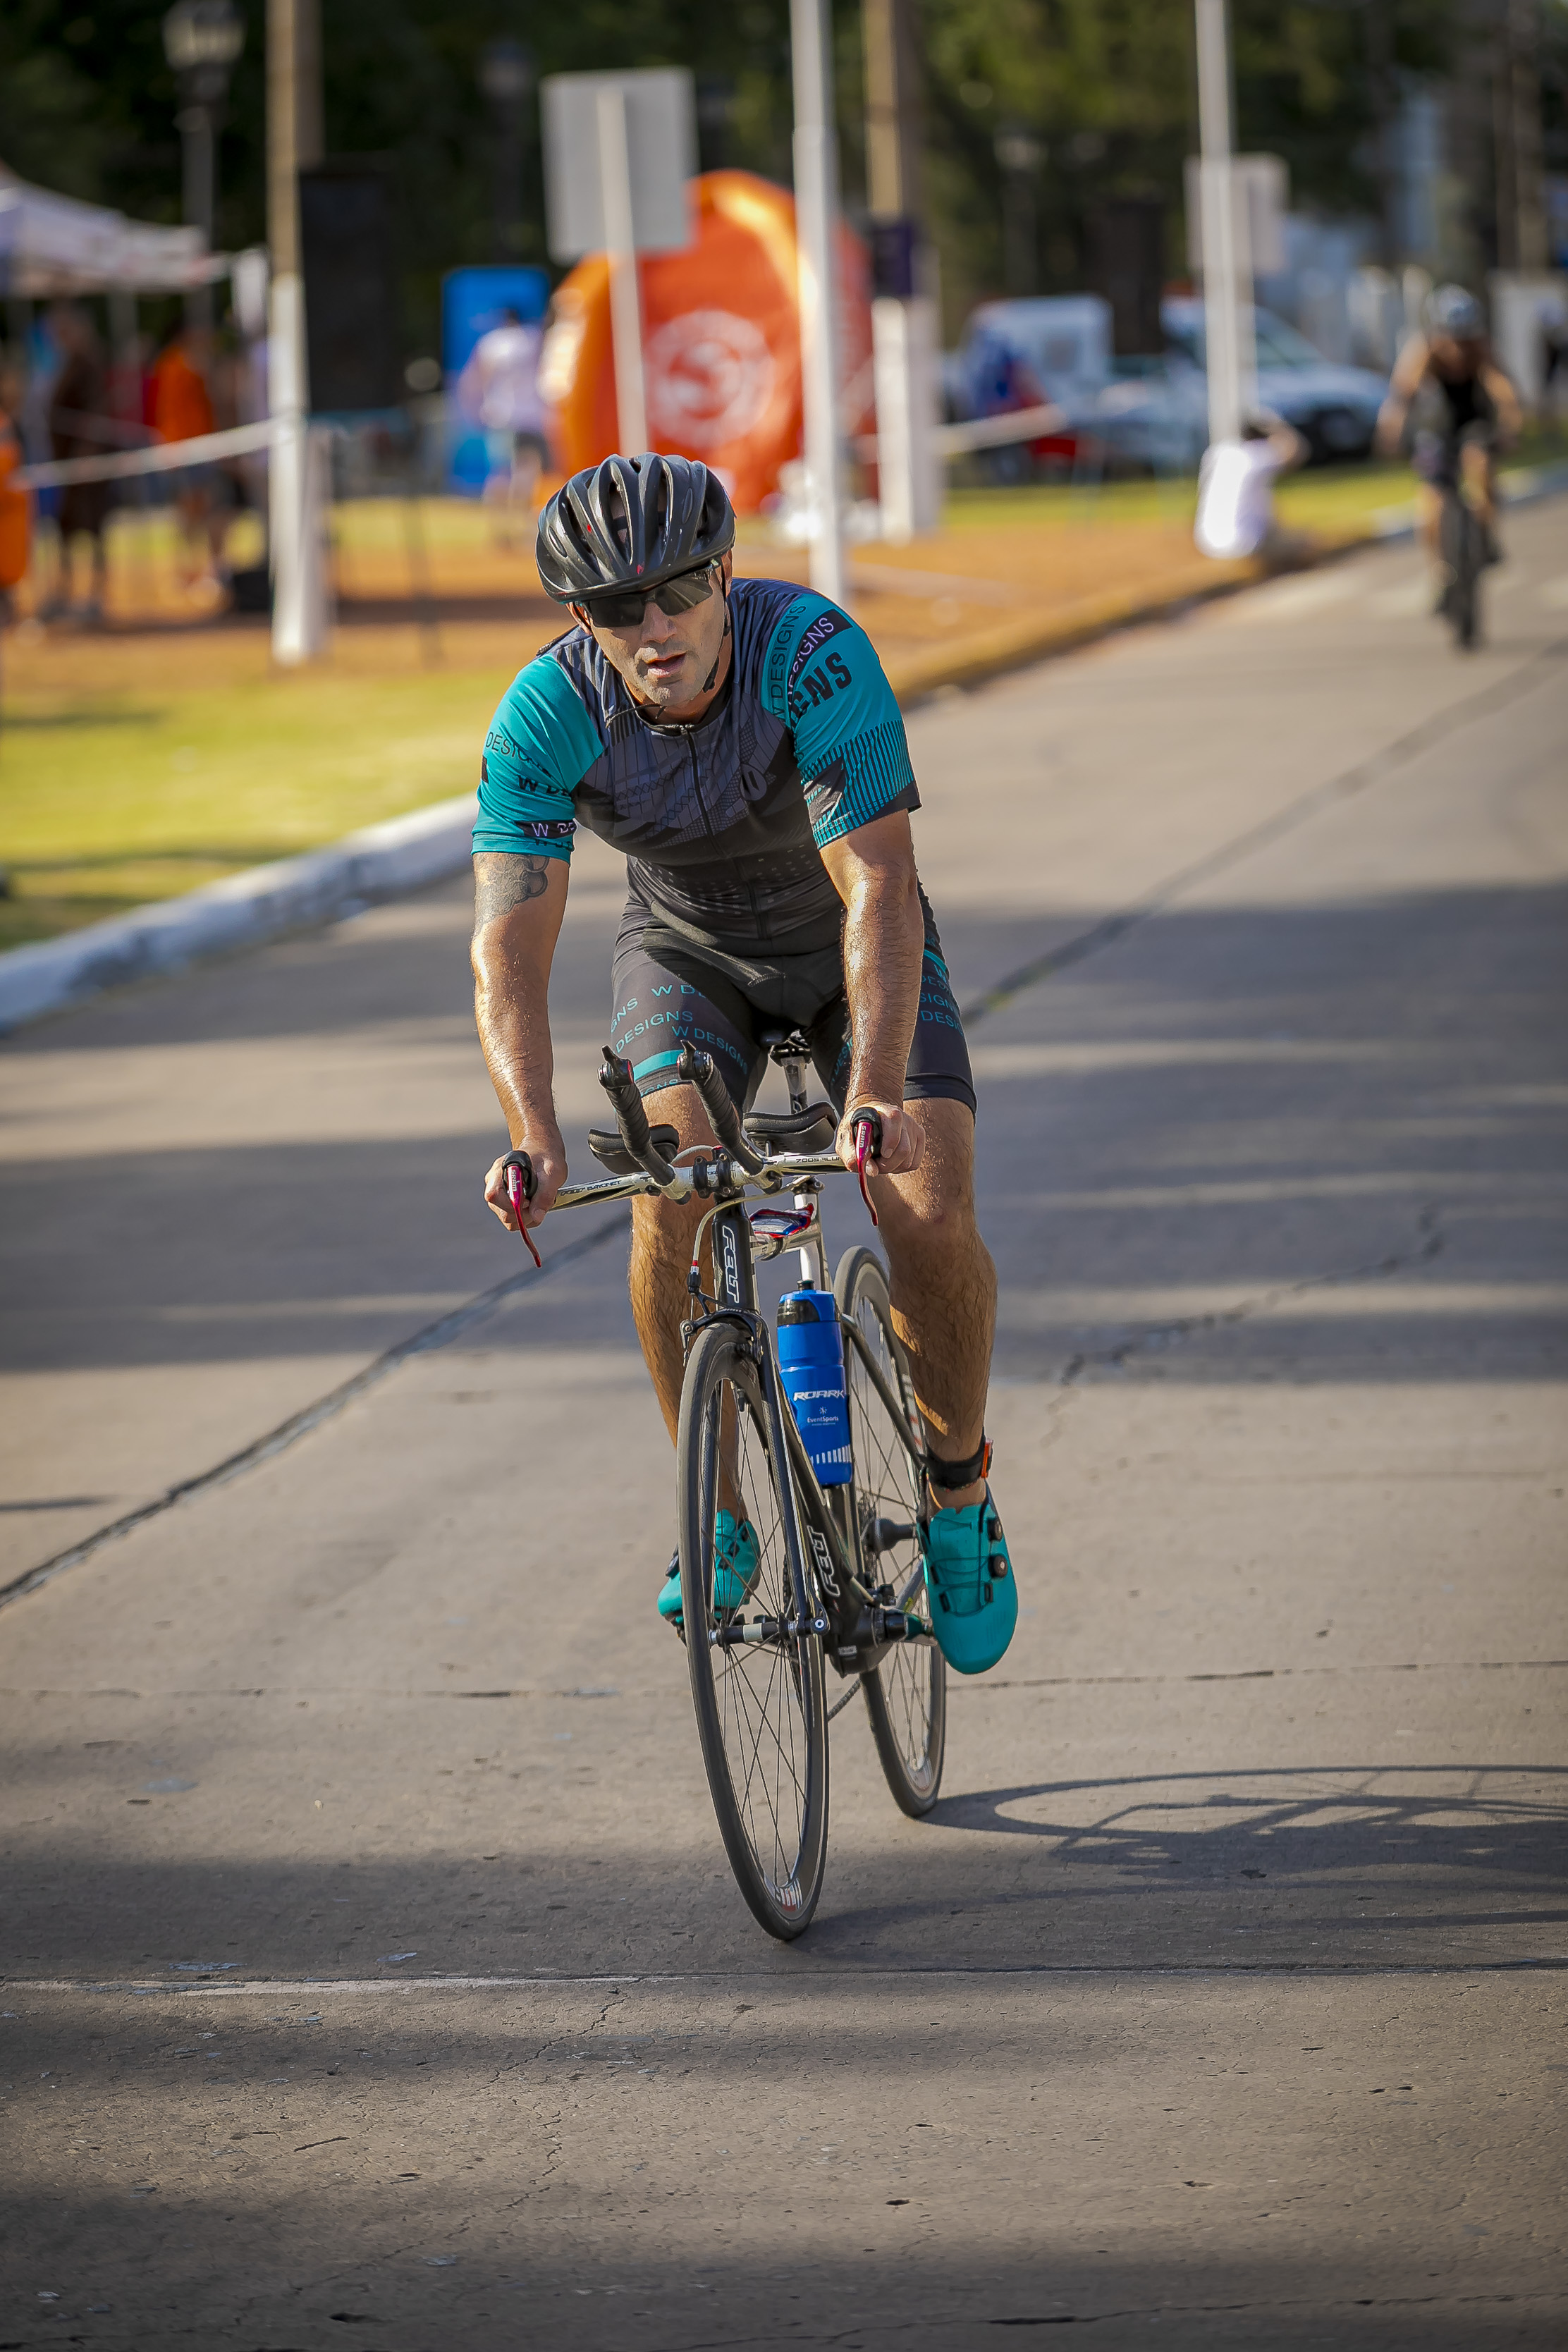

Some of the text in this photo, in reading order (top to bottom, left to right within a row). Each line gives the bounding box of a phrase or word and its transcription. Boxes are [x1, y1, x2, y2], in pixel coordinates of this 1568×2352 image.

[770, 605, 807, 699] DESIGNS
[532, 823, 549, 837] W
[651, 985, 673, 998] W
[615, 1010, 693, 1054] DESIGNS
[671, 1026, 748, 1075] W DESIGNS
[722, 1225, 740, 1304] FELT
[793, 1389, 845, 1402] ROARK
